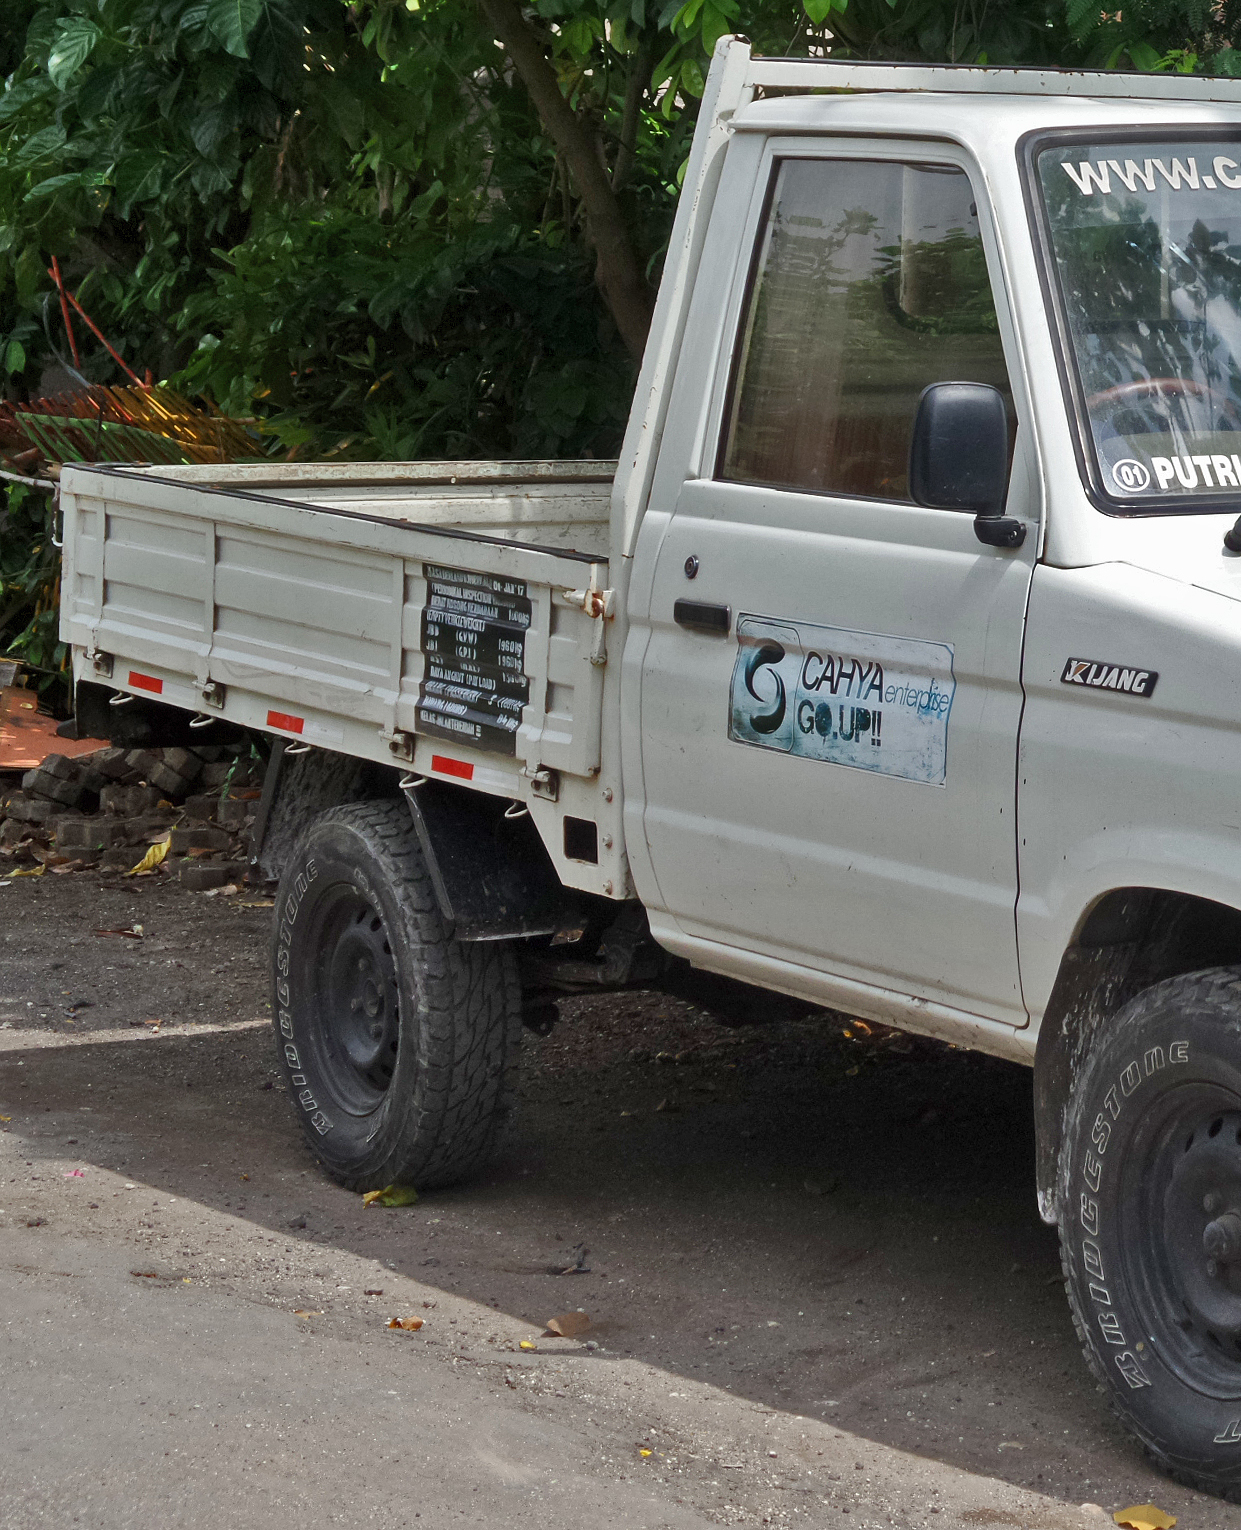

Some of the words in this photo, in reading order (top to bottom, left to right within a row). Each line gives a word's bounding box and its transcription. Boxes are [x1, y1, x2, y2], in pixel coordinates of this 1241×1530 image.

[801, 651, 884, 703] CAHYA
[1065, 660, 1149, 693] KIJANG
[1080, 1041, 1190, 1389] BRIDGESTONE
